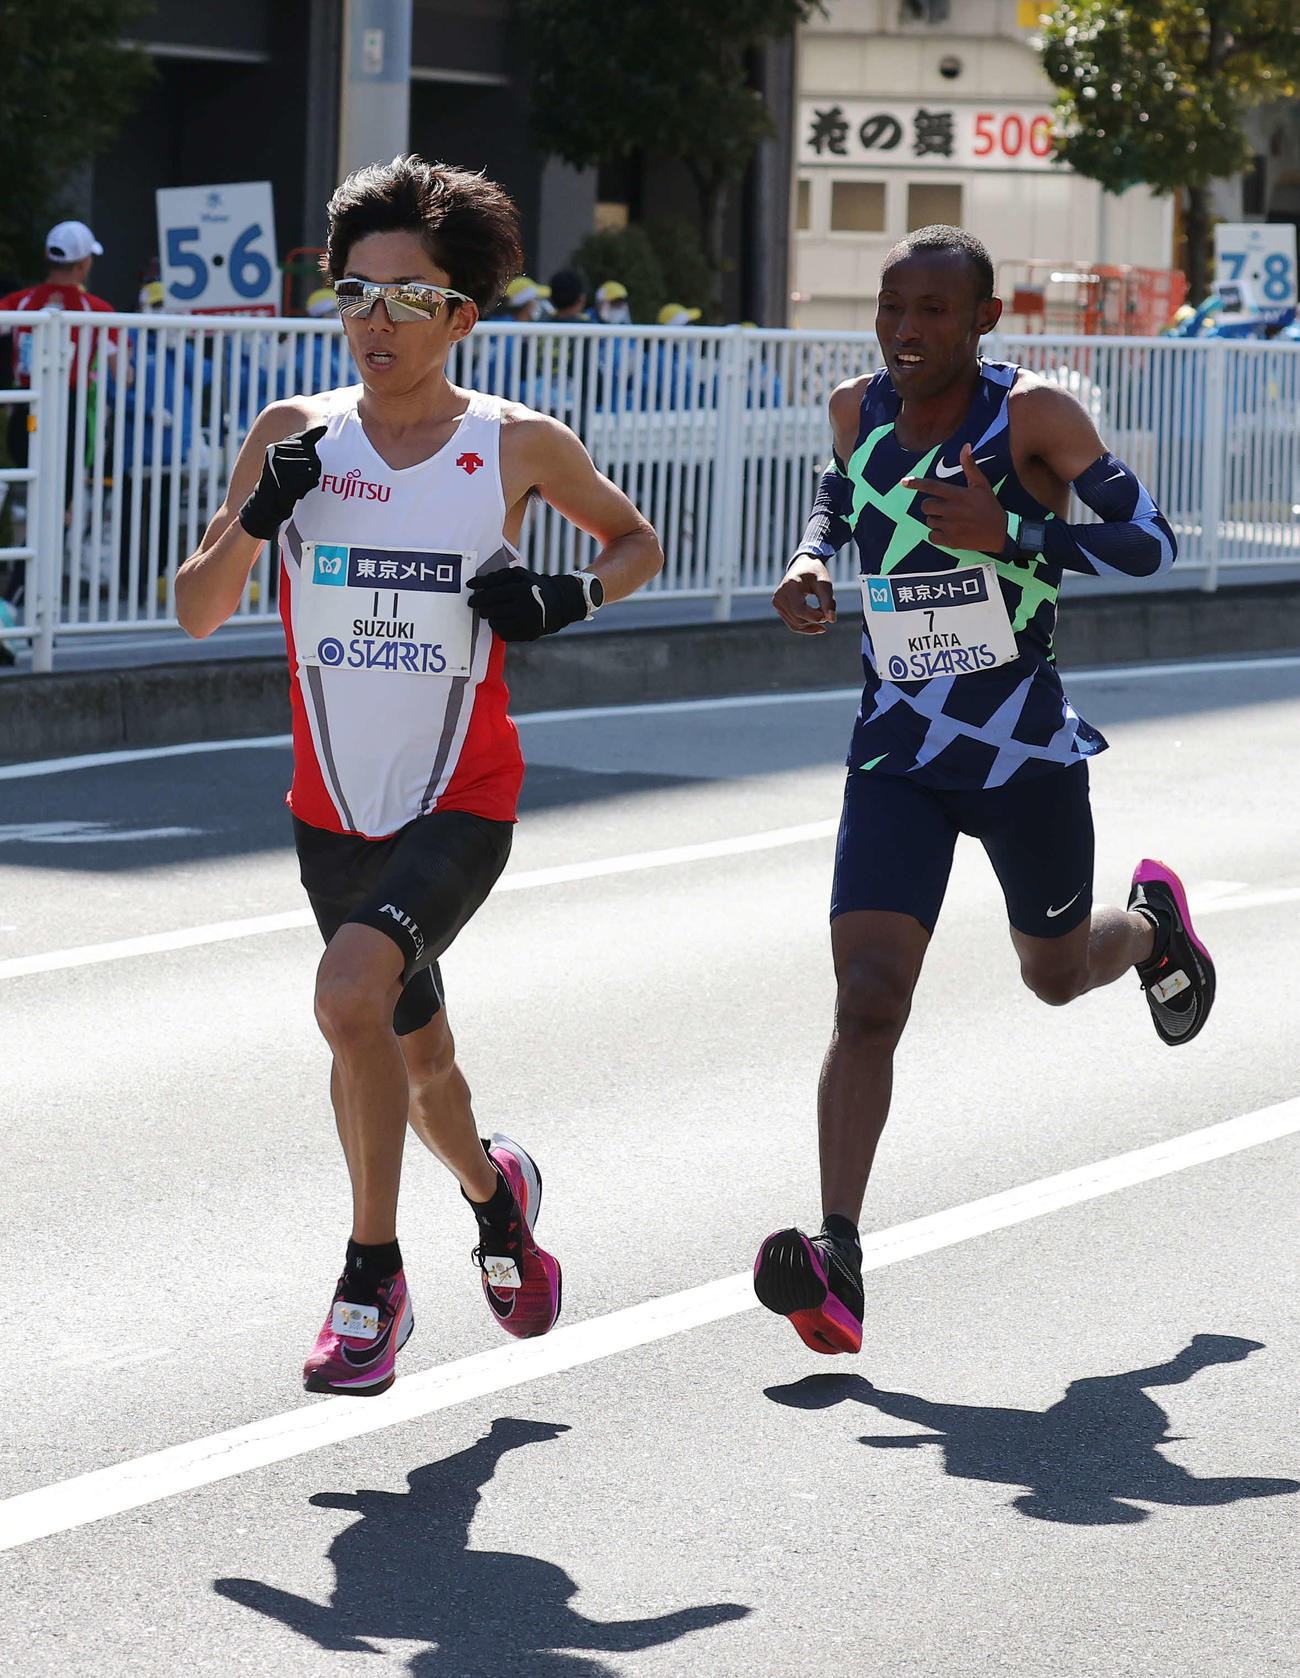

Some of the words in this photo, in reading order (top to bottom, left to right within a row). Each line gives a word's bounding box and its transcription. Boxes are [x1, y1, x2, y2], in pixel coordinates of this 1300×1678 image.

[808, 103, 954, 157] 花の舞
[321, 469, 391, 503] FUJITSU
[356, 558, 453, 582] 東京メトロ
[897, 579, 979, 603] 東京メトロ
[373, 592, 399, 618] 11
[353, 619, 414, 639] SUZUKI
[923, 611, 935, 632] 7
[908, 633, 961, 652] KITATA
[348, 639, 446, 673] STARTS
[911, 644, 996, 678] STARTS
